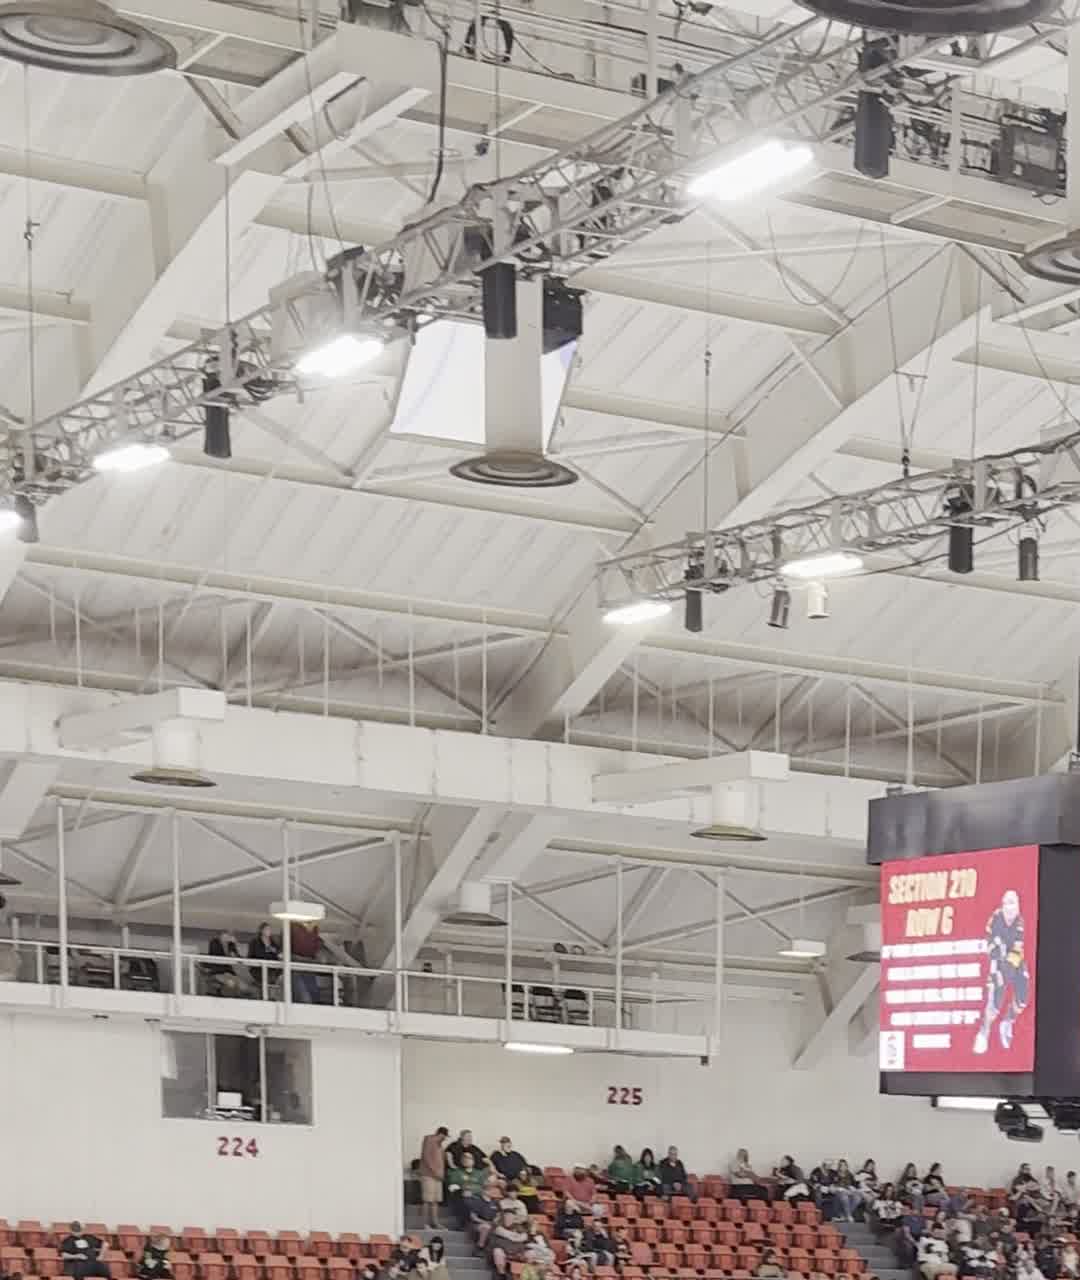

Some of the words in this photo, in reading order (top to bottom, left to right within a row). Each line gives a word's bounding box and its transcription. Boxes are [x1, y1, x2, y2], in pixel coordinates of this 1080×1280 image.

[949, 868, 977, 899] 210
[608, 1086, 643, 1105] 225
[217, 1136, 259, 1158] 224
